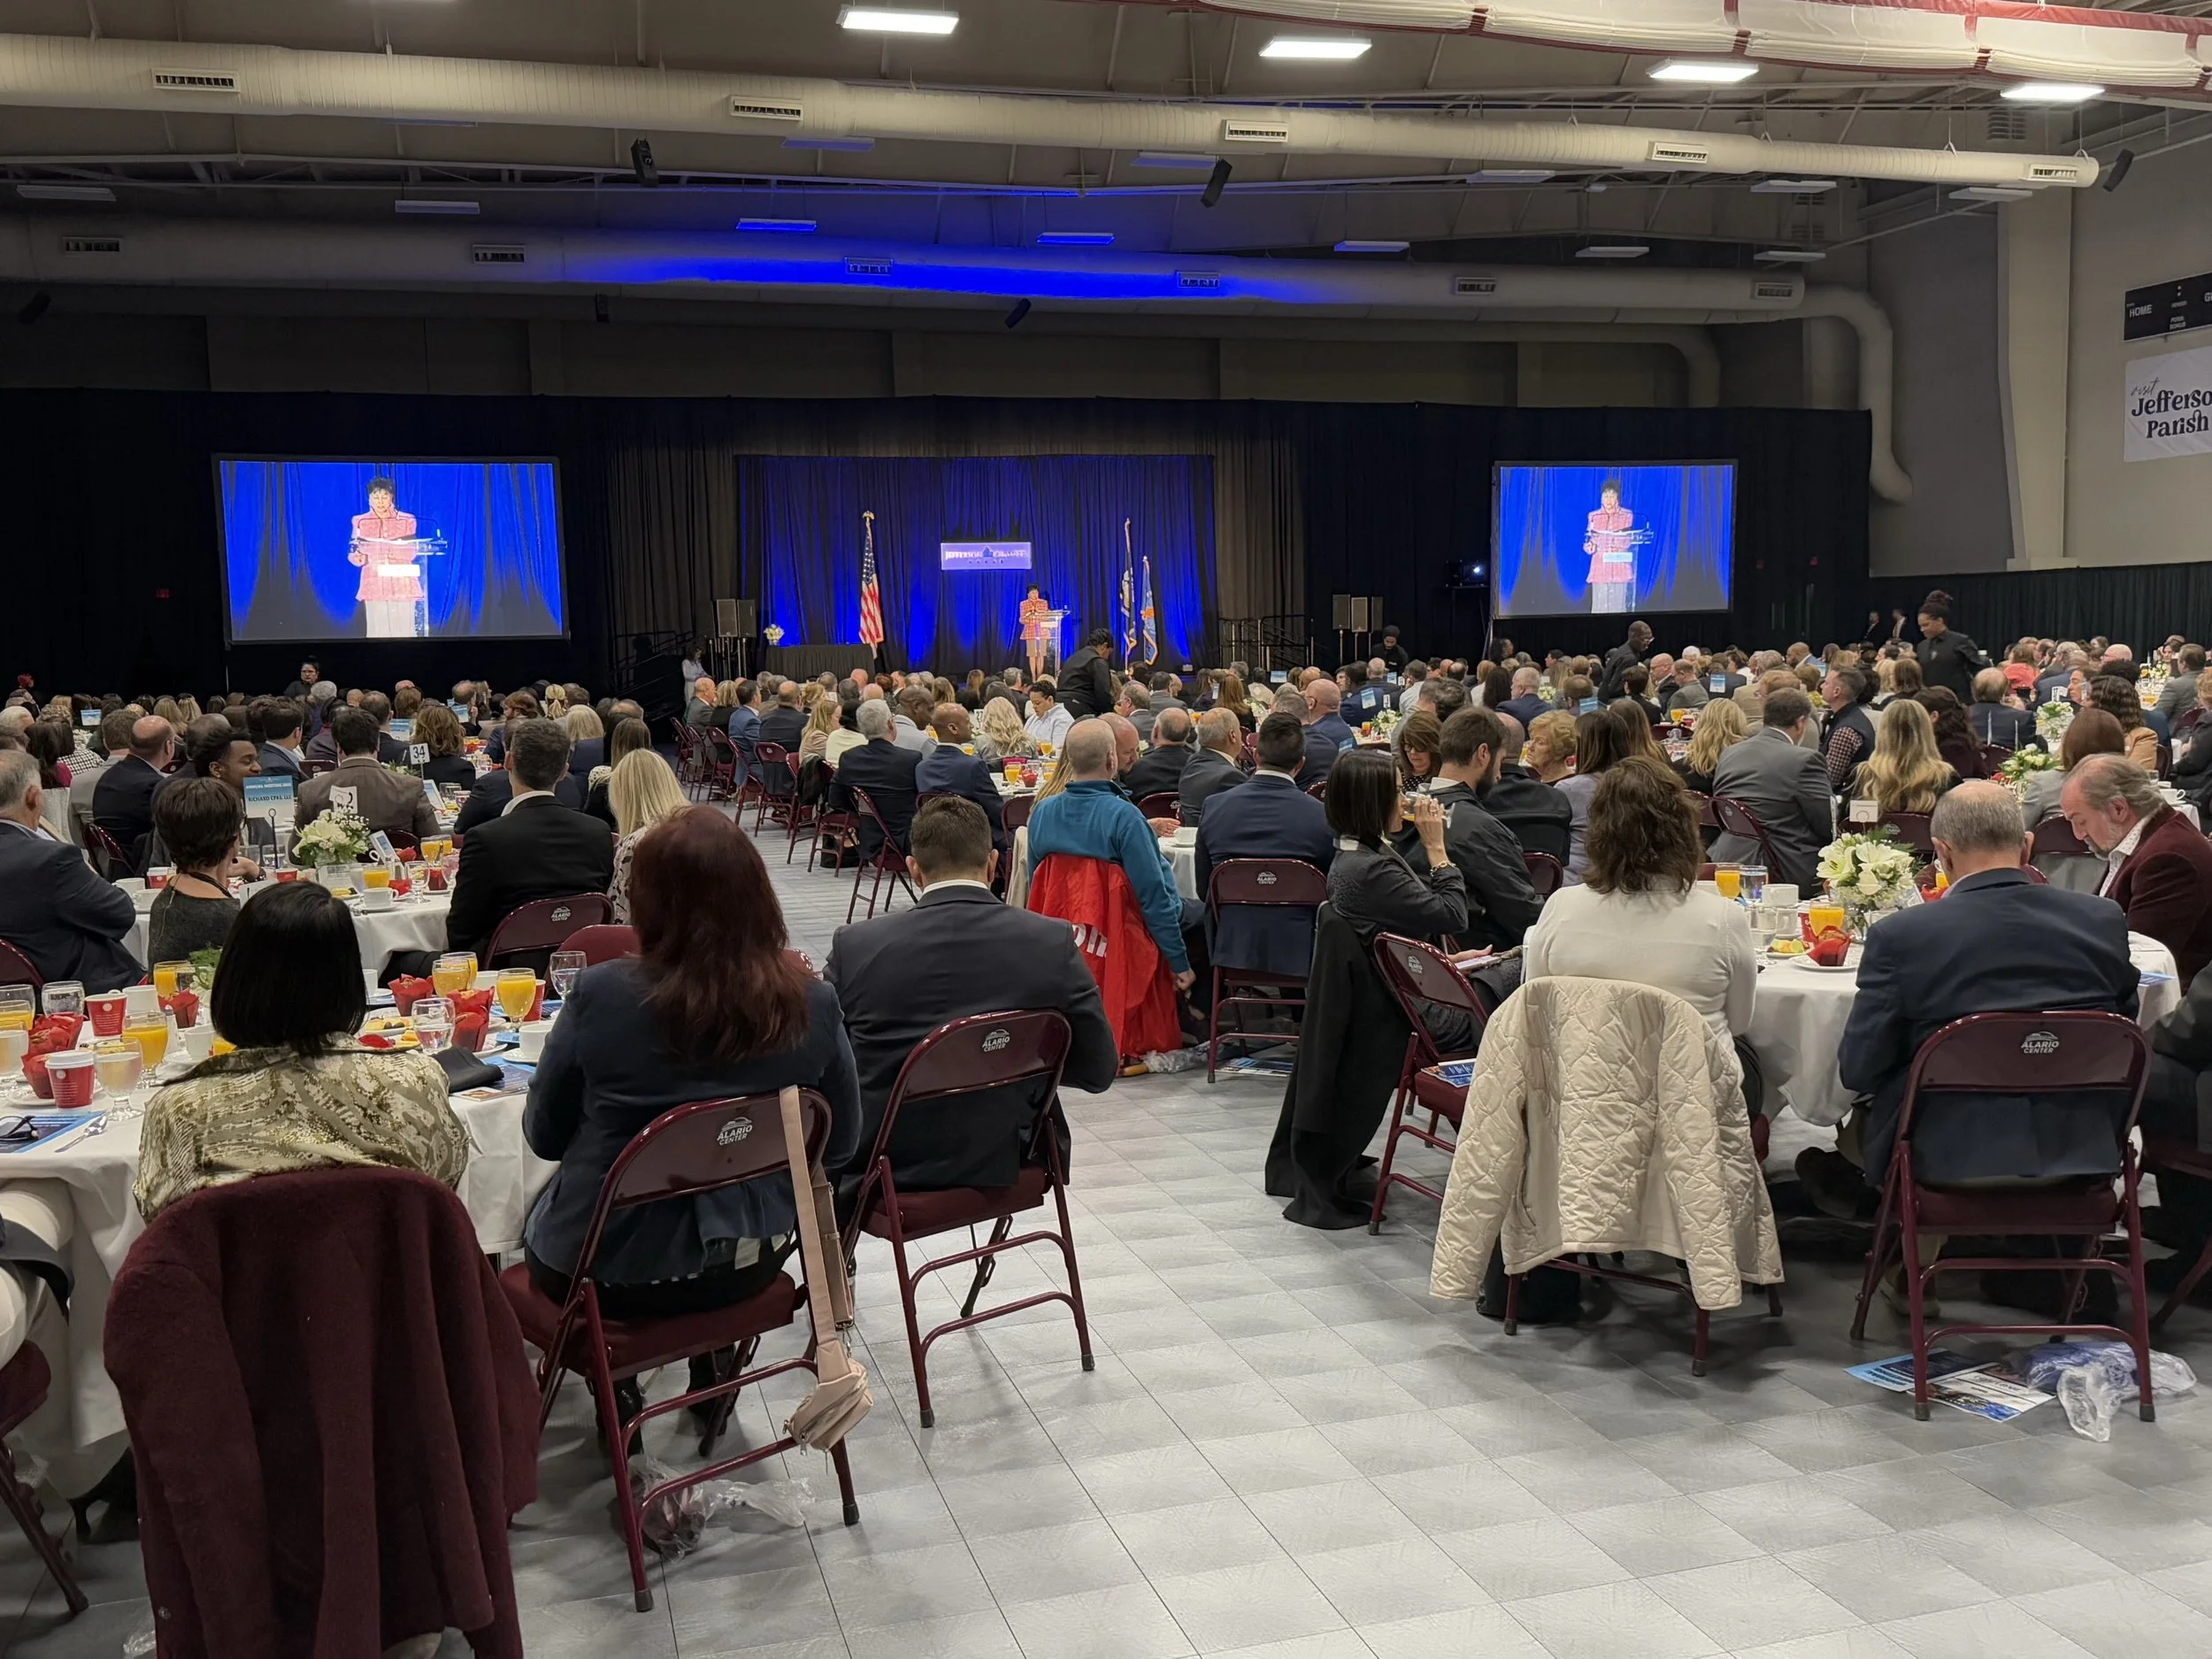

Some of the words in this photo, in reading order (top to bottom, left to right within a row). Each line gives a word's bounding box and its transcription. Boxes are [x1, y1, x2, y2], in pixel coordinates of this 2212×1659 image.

[2129, 304, 2153, 319] HOME
[2131, 377, 2161, 397] visit
[2147, 410, 2209, 439] Parish
[413, 745, 426, 759] 34
[982, 1036, 1010, 1048] ALARIO
[984, 1043, 1006, 1052] CENTER
[717, 1125, 753, 1141] ALARIO
[719, 1133, 748, 1146] CENTER
